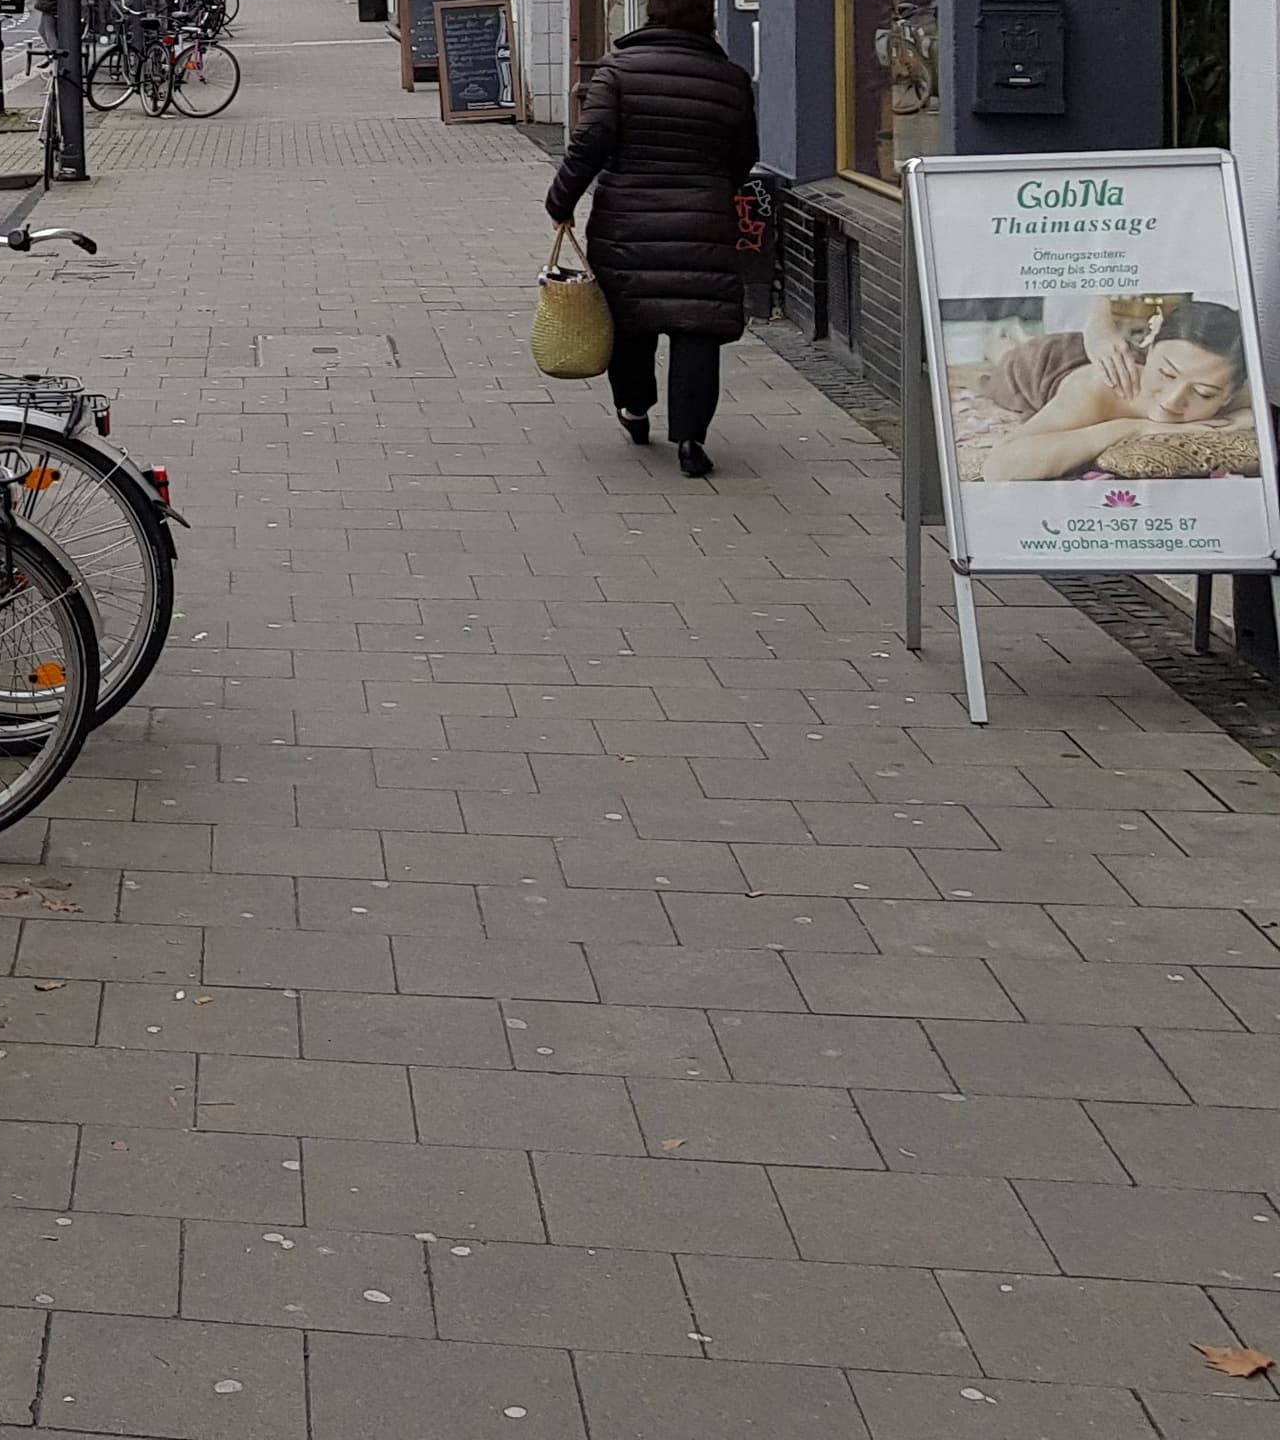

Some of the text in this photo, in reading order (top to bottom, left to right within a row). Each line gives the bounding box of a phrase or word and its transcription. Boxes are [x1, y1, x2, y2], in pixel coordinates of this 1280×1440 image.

[1017, 179, 1125, 209] GobNa
[991, 215, 1158, 236] Thaimassage
[1033, 247, 1127, 262] Öffnungszeiten:
[1020, 263, 1139, 277] Montag bis Sonntag
[1024, 277, 1140, 290] 11:00 bis 20:00 Uhr
[1067, 518, 1198, 532] 0221-367 925 87
[1020, 536, 1221, 553] www.gobna-massage.com
